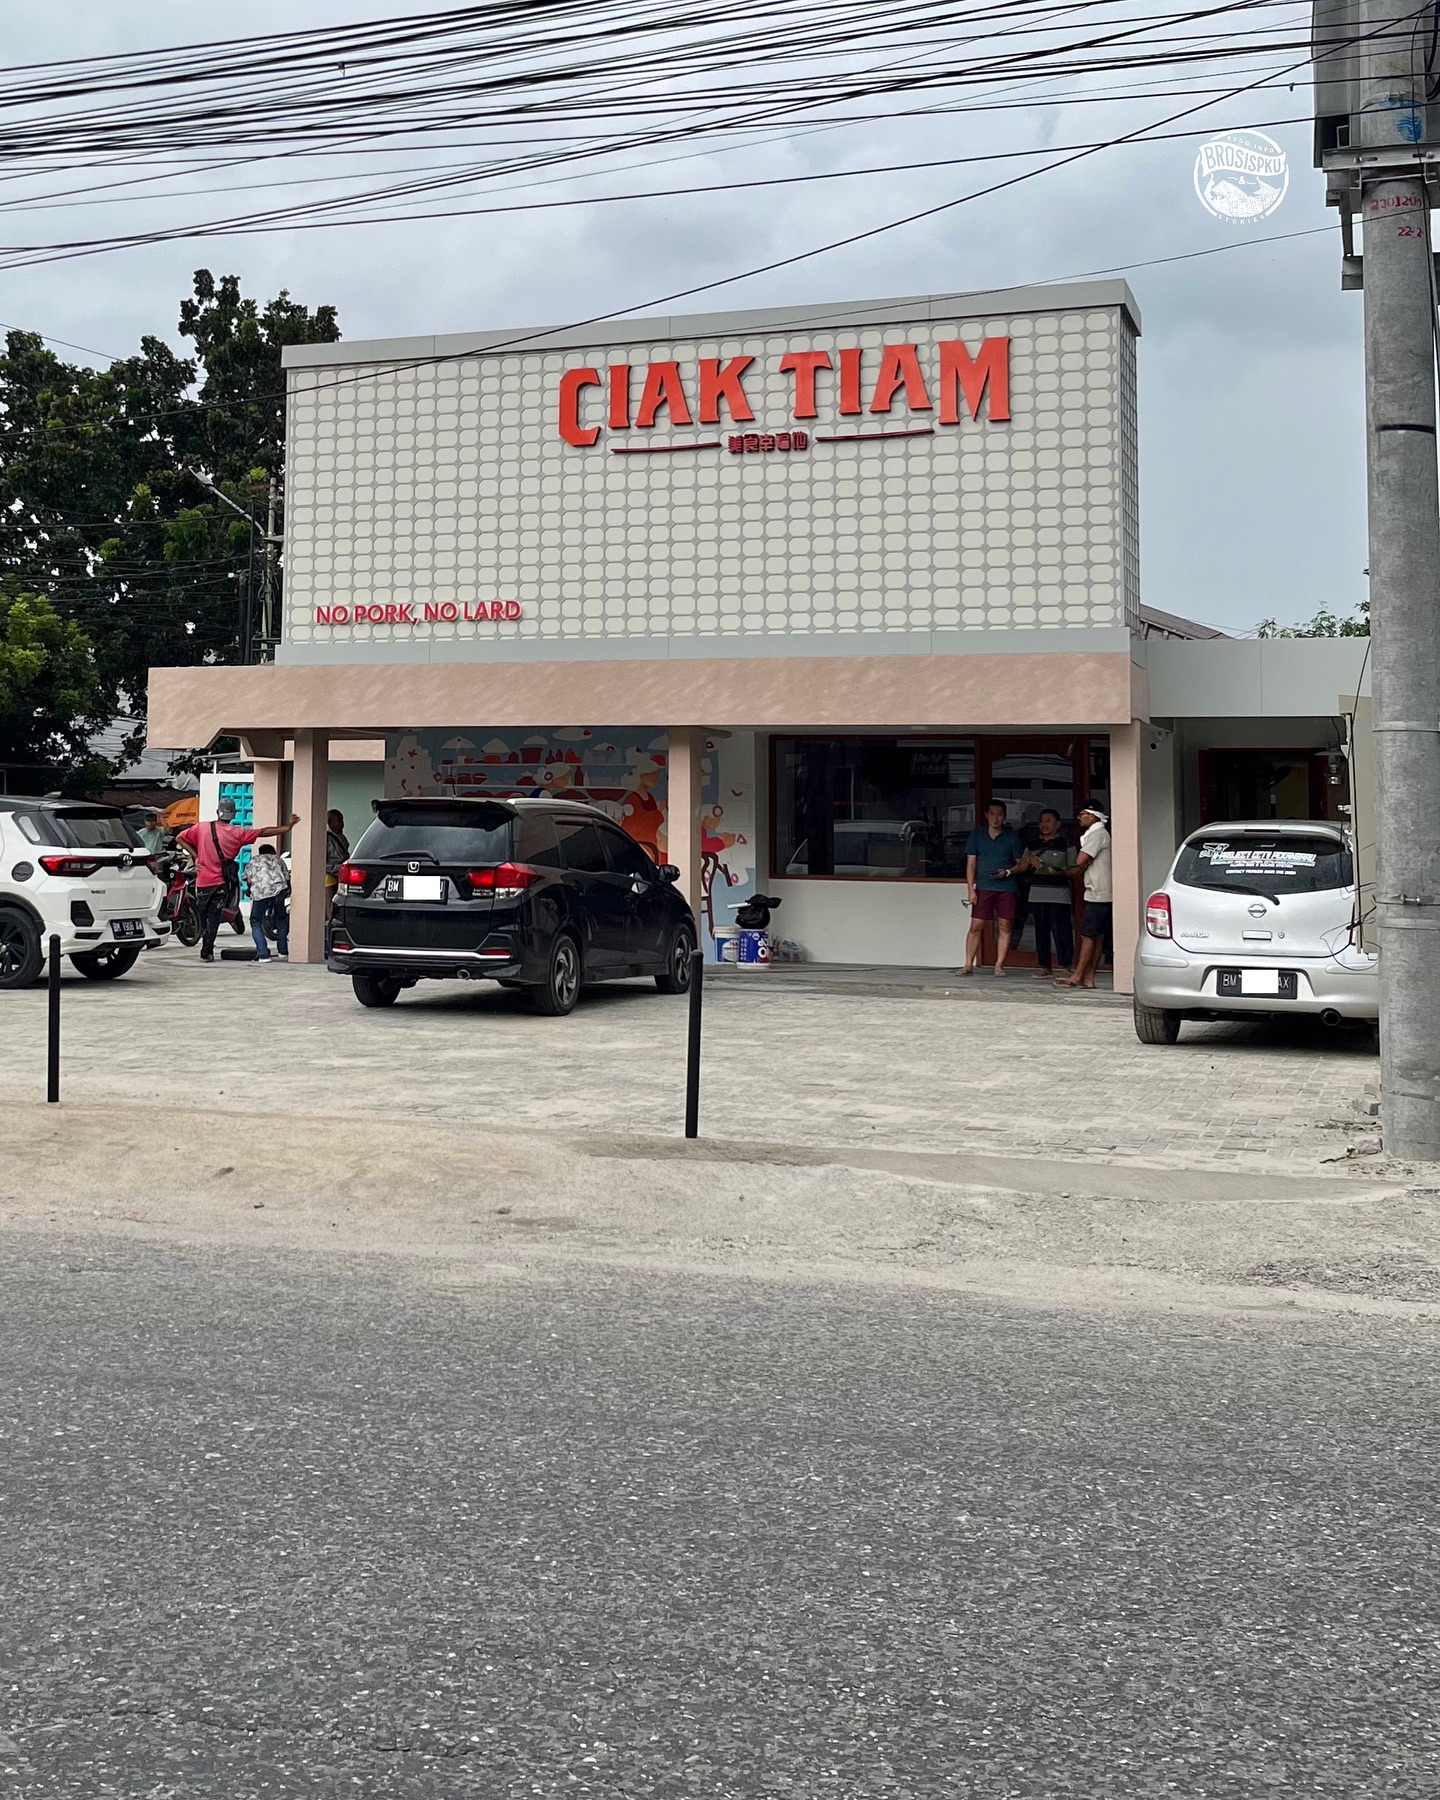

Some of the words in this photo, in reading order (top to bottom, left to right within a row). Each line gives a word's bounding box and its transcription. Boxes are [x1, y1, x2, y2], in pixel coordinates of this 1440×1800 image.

[559, 356, 755, 447] CIAK
[780, 336, 1011, 426] TIAM
[316, 605, 348, 625] NO
[353, 603, 419, 626] PORK,
[424, 602, 457, 622] NO
[463, 600, 521, 621] LARD
[1222, 974, 1237, 987] BM
